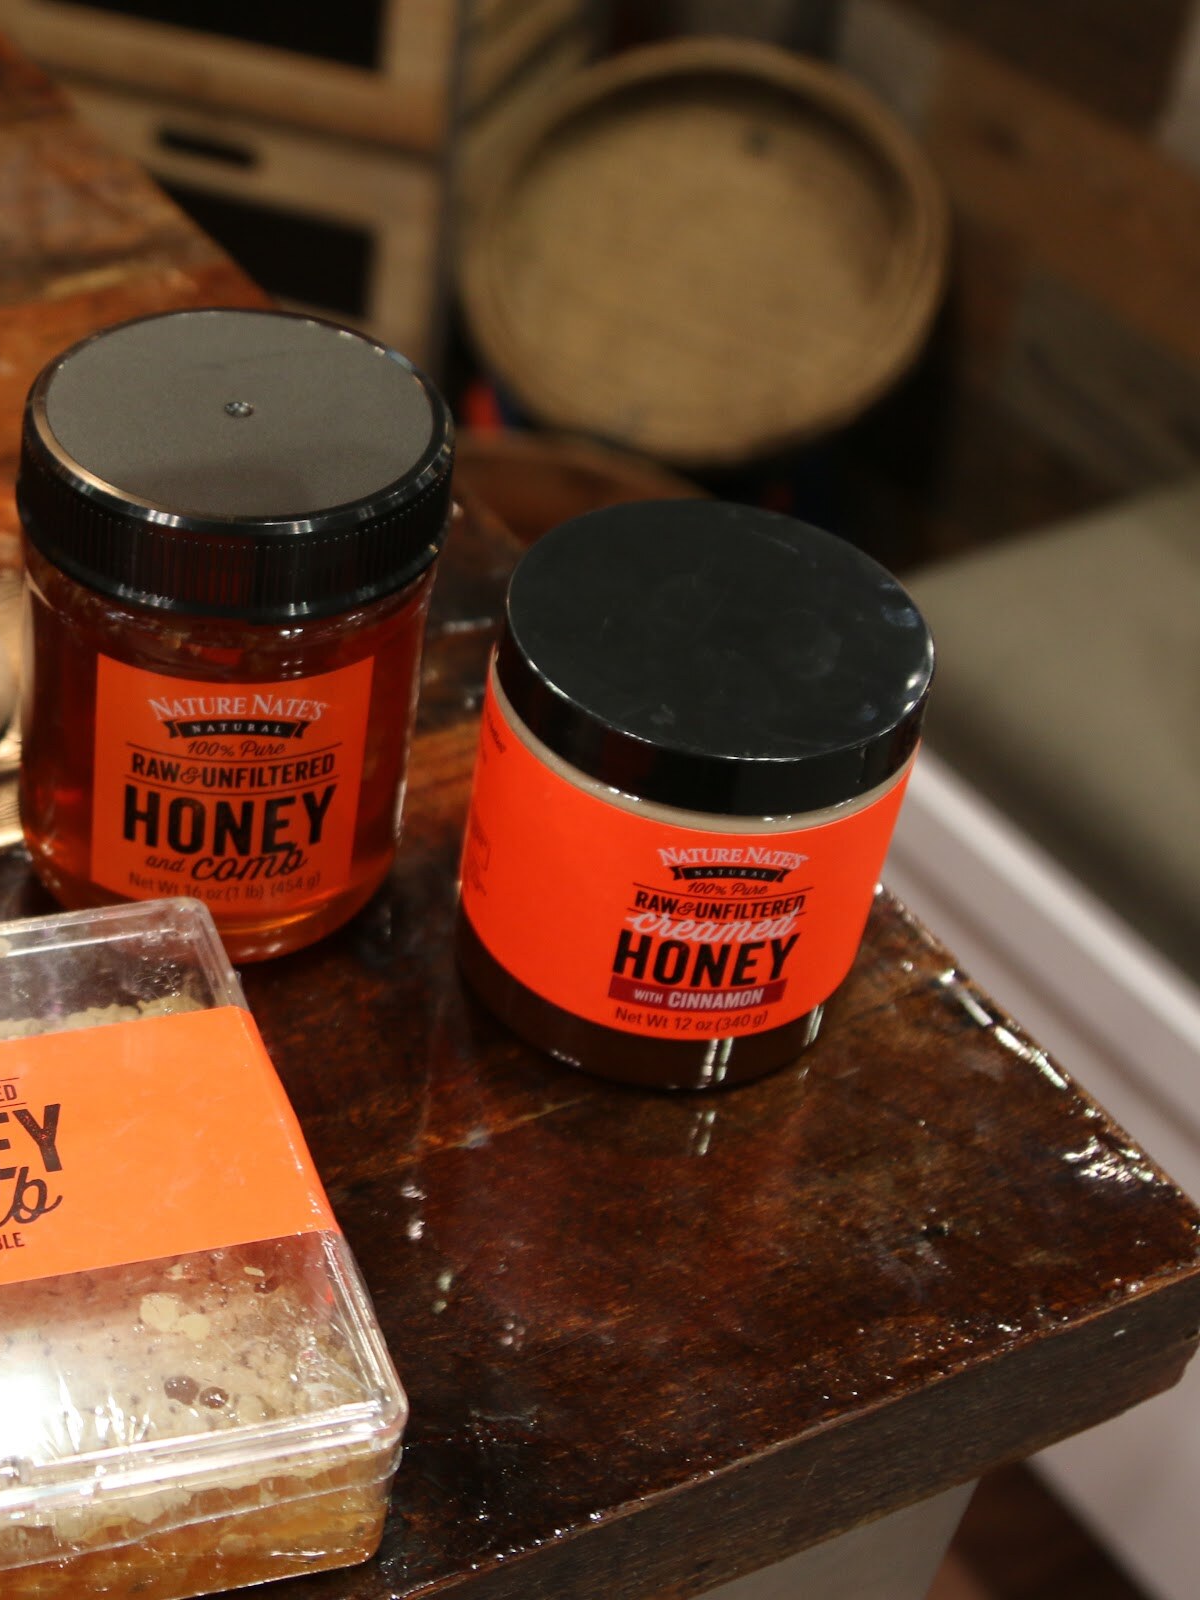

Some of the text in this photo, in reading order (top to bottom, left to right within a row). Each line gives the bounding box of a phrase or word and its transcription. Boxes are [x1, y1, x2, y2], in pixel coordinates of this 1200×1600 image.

[148, 693, 328, 721] NATURE NATE'S
[192, 723, 282, 734] NATURAL
[187, 740, 286, 757] 100% Pure
[123, 784, 337, 857] HONEY
[145, 842, 309, 882] and comb
[657, 847, 742, 866] NATURE
[695, 870, 767, 878] NATURAL
[688, 882, 769, 895] 100% Pure
[625, 906, 800, 942] creamed
[613, 929, 801, 987] HONEY
[634, 988, 764, 1010] WITH CINNAMON
[615, 1007, 768, 1032] Net Wt 12 oz (340 g)
